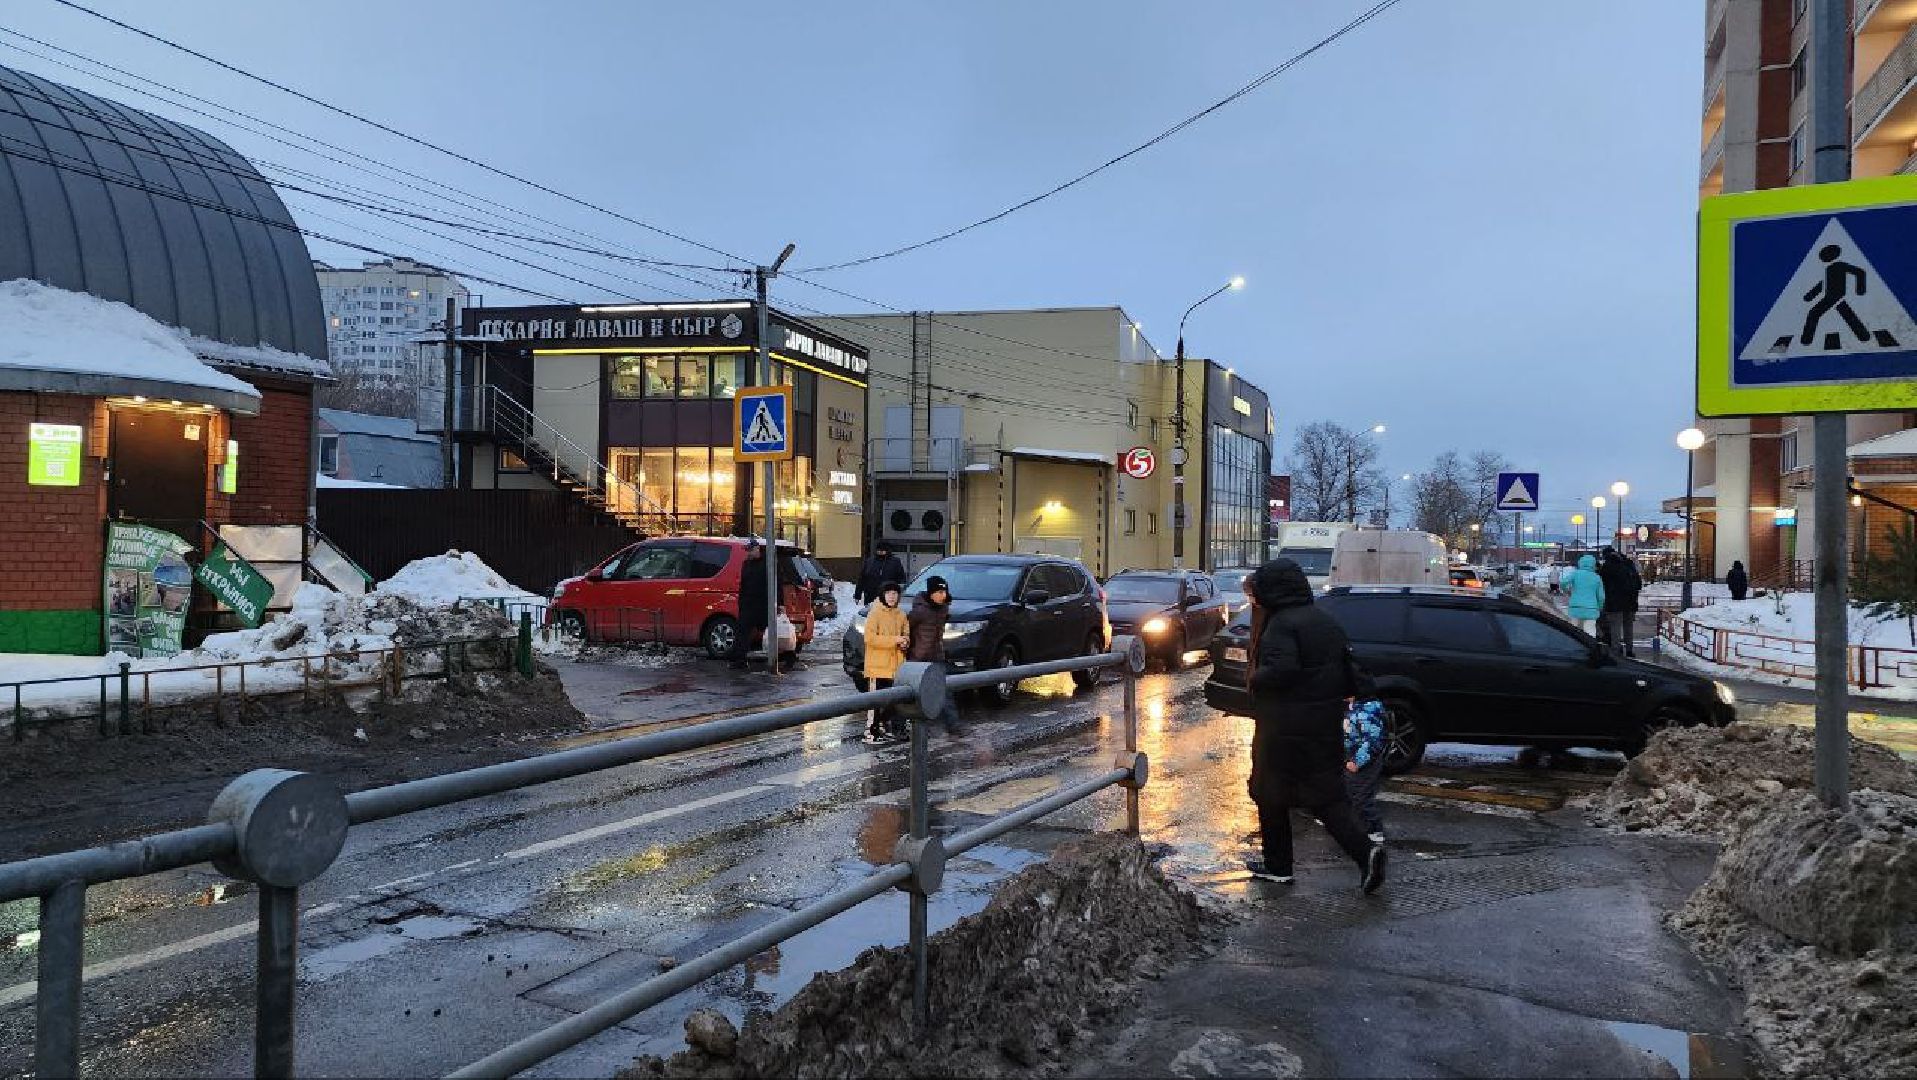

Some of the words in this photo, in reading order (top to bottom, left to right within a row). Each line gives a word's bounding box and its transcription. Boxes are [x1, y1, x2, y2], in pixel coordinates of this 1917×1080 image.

[571, 319, 643, 338] ЛАВАШ
[650, 318, 664, 337] И
[670, 316, 716, 337] СЫР
